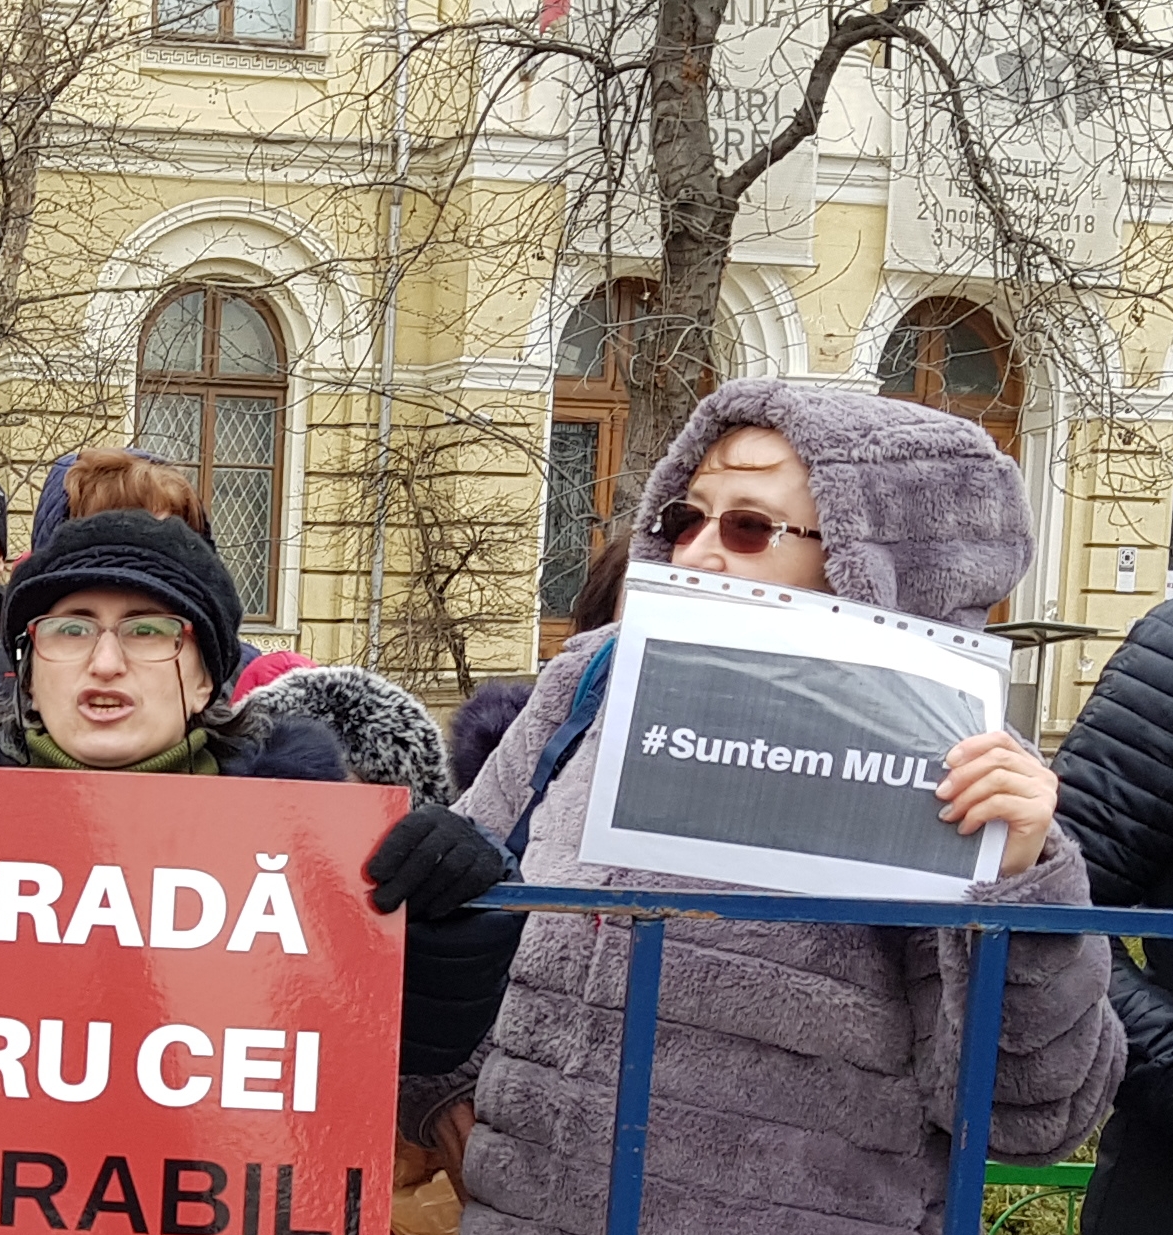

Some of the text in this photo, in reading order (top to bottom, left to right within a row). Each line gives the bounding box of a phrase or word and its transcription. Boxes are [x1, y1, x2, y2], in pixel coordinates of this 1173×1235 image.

[1051, 213, 1095, 233] 2018
[641, 724, 951, 791] #Suntem MUL
[137, 1024, 320, 1112] CEI
